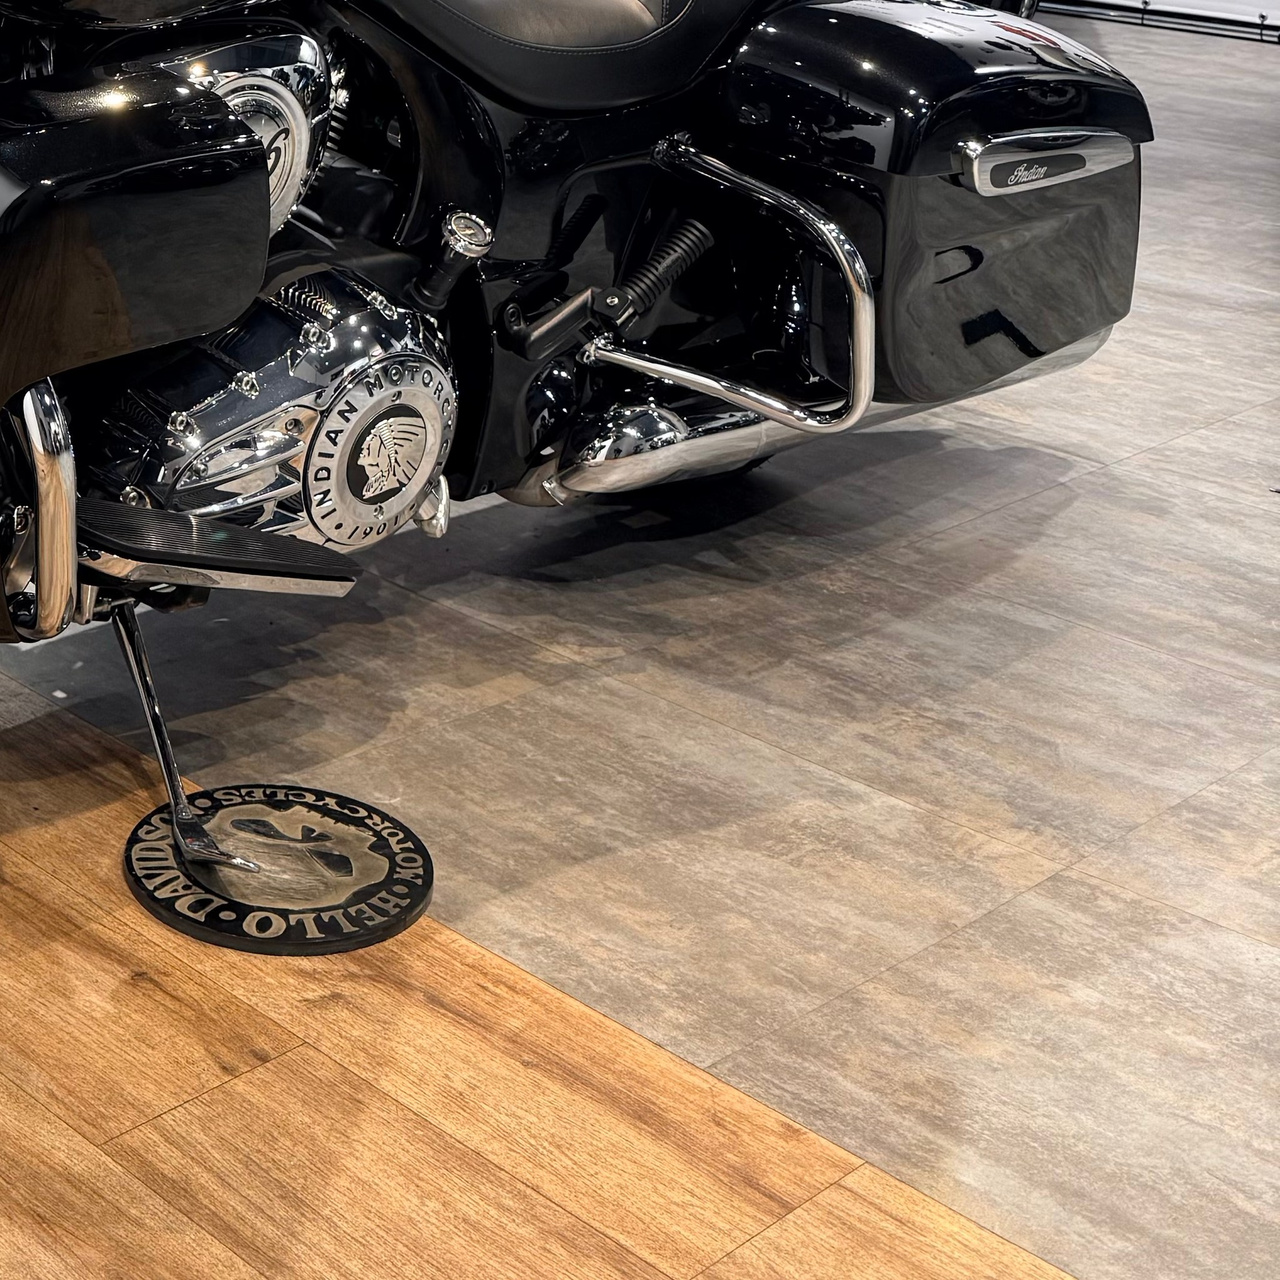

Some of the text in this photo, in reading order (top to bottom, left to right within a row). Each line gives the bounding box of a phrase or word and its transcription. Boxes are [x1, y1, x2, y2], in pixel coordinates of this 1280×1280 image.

[1007, 163, 1048, 186] Indian
[313, 399, 360, 520] INDIAN
[347, 514, 400, 541] 1901
[131, 805, 412, 939] HELLO DAVIDS
[212, 787, 425, 886] MOTORCYCLES
